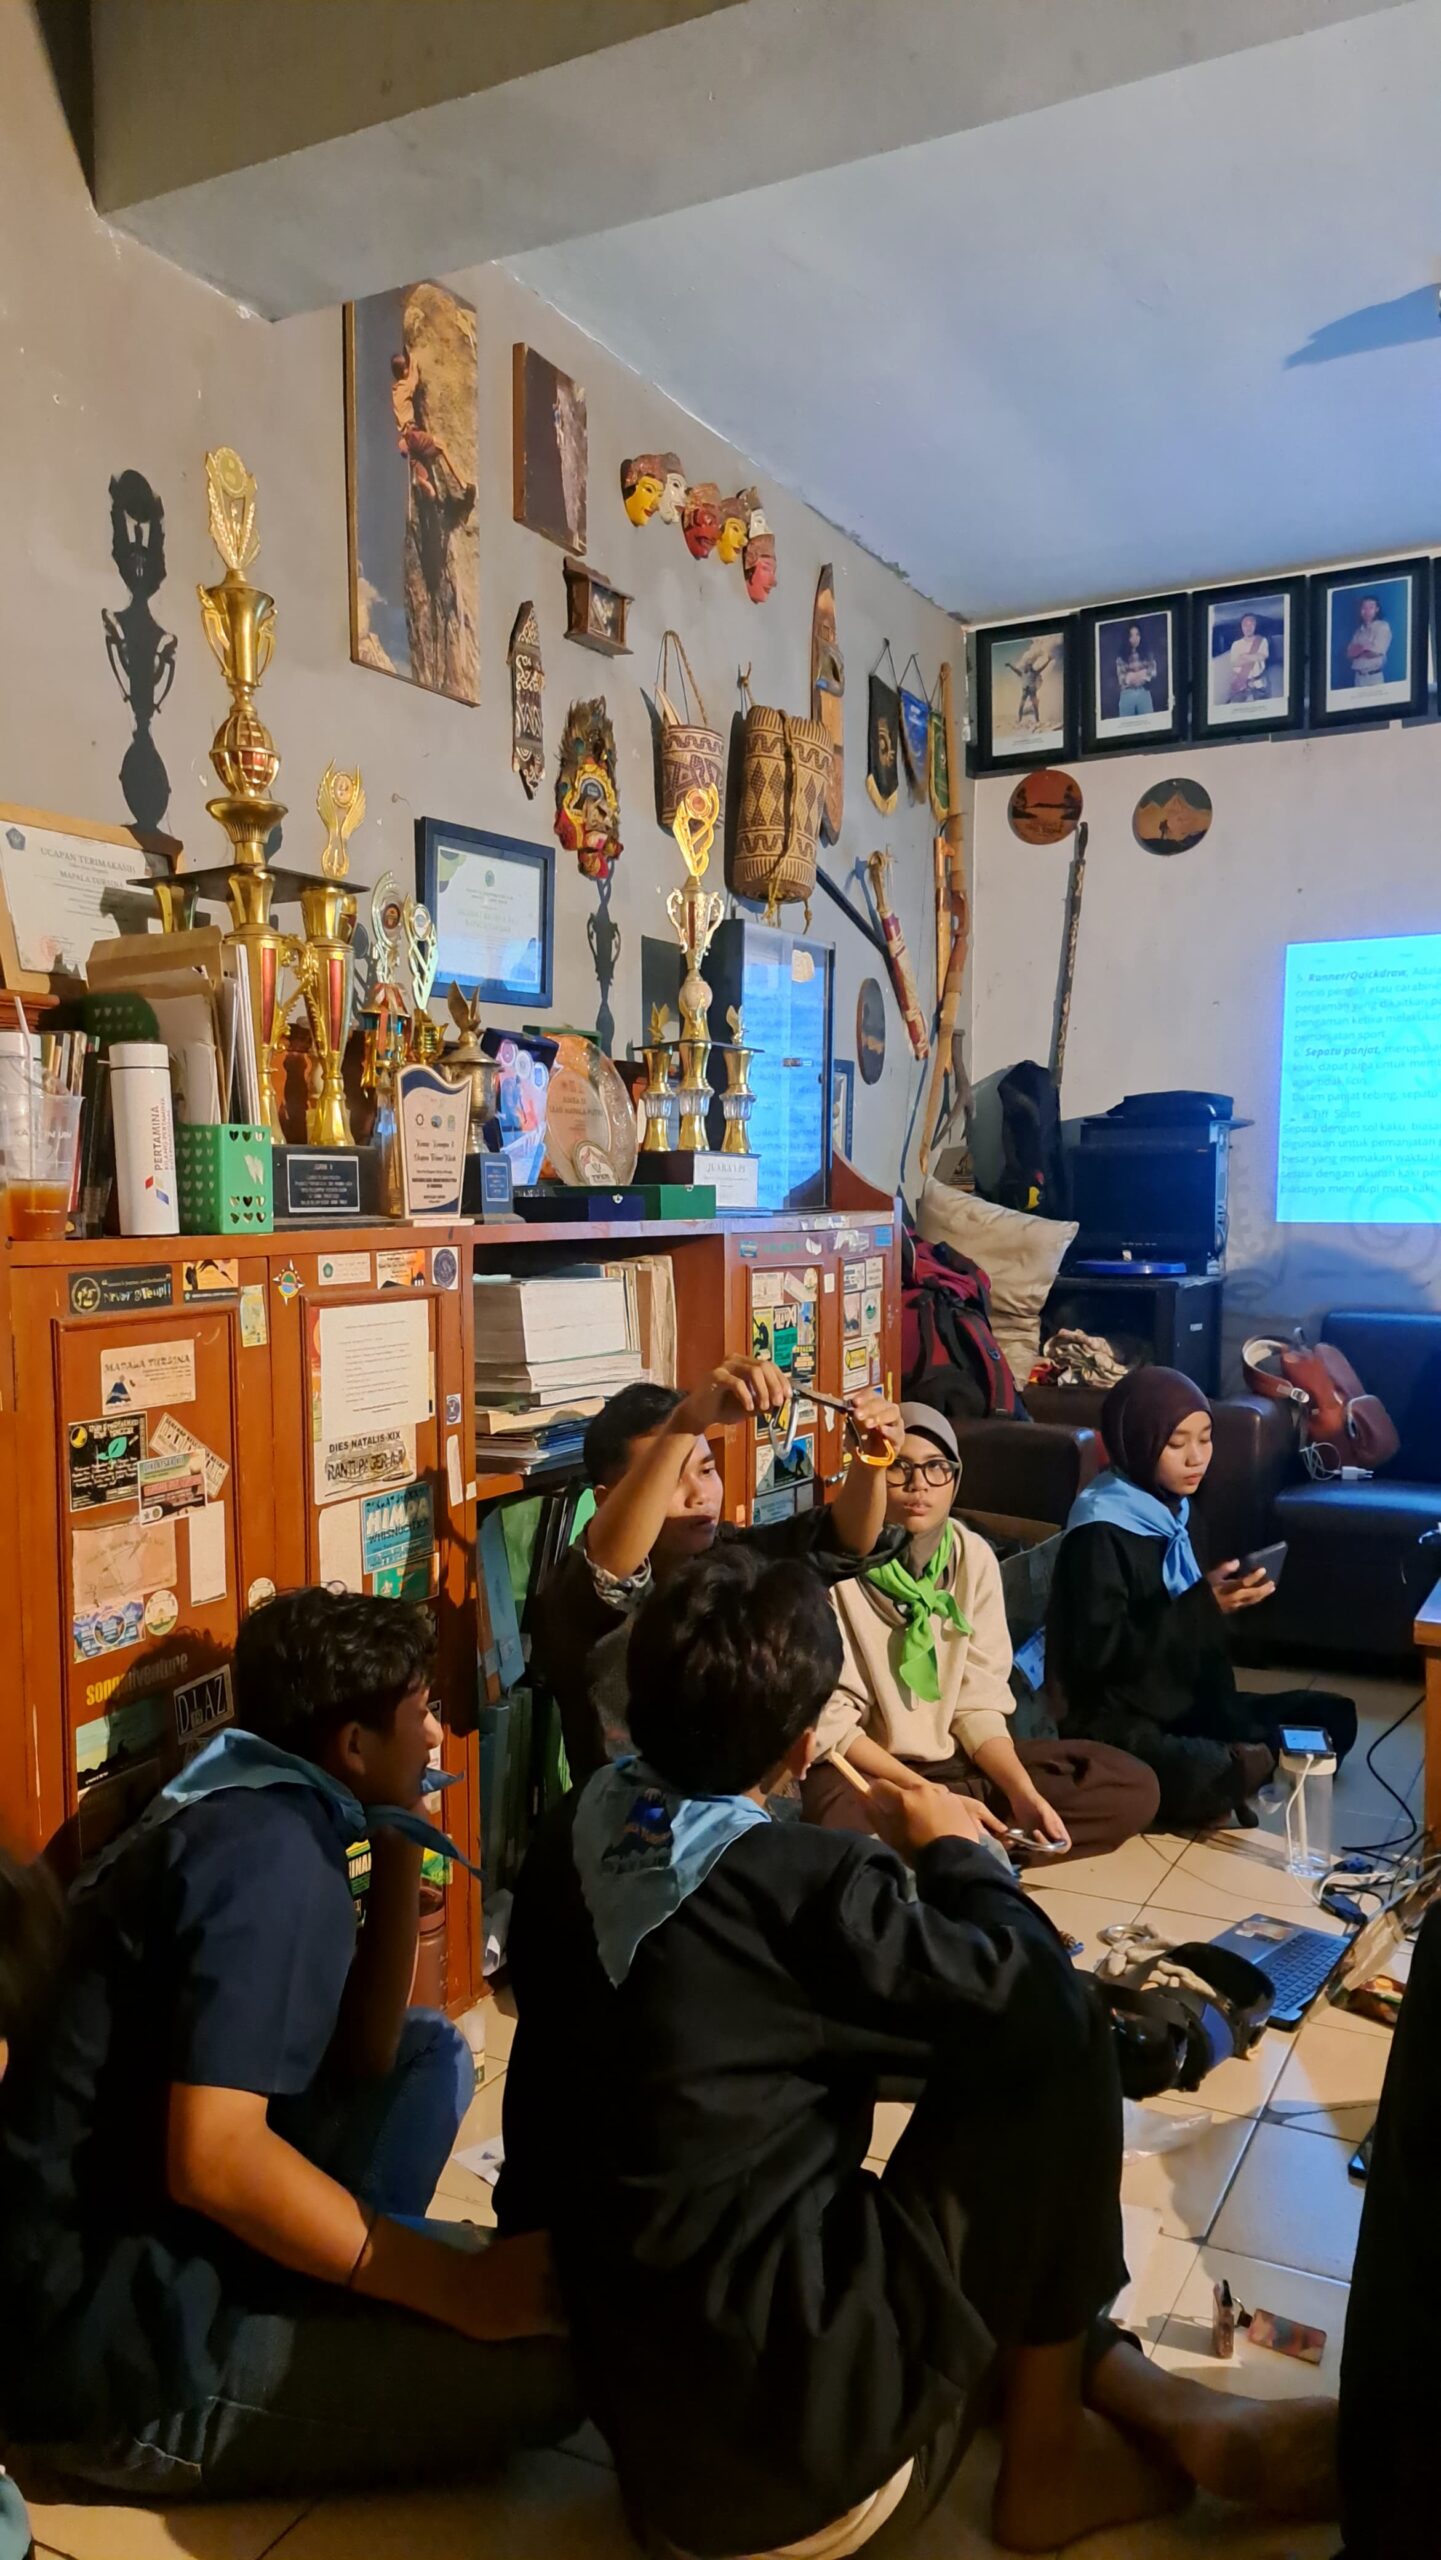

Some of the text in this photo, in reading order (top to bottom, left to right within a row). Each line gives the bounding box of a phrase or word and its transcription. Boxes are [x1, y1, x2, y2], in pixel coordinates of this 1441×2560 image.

[40, 847, 77, 863] UCAPAN
[1305, 1047, 1341, 1059] Sepatu
[1343, 1045, 1381, 1057] panjat,
[151, 1104, 163, 1171] PERTAMINA
[329, 1439, 349, 1453] DIES
[351, 1434, 385, 1448] NATALIS
[366, 1496, 429, 1536] HIMPA
[177, 1674, 226, 1735] DIAZ
